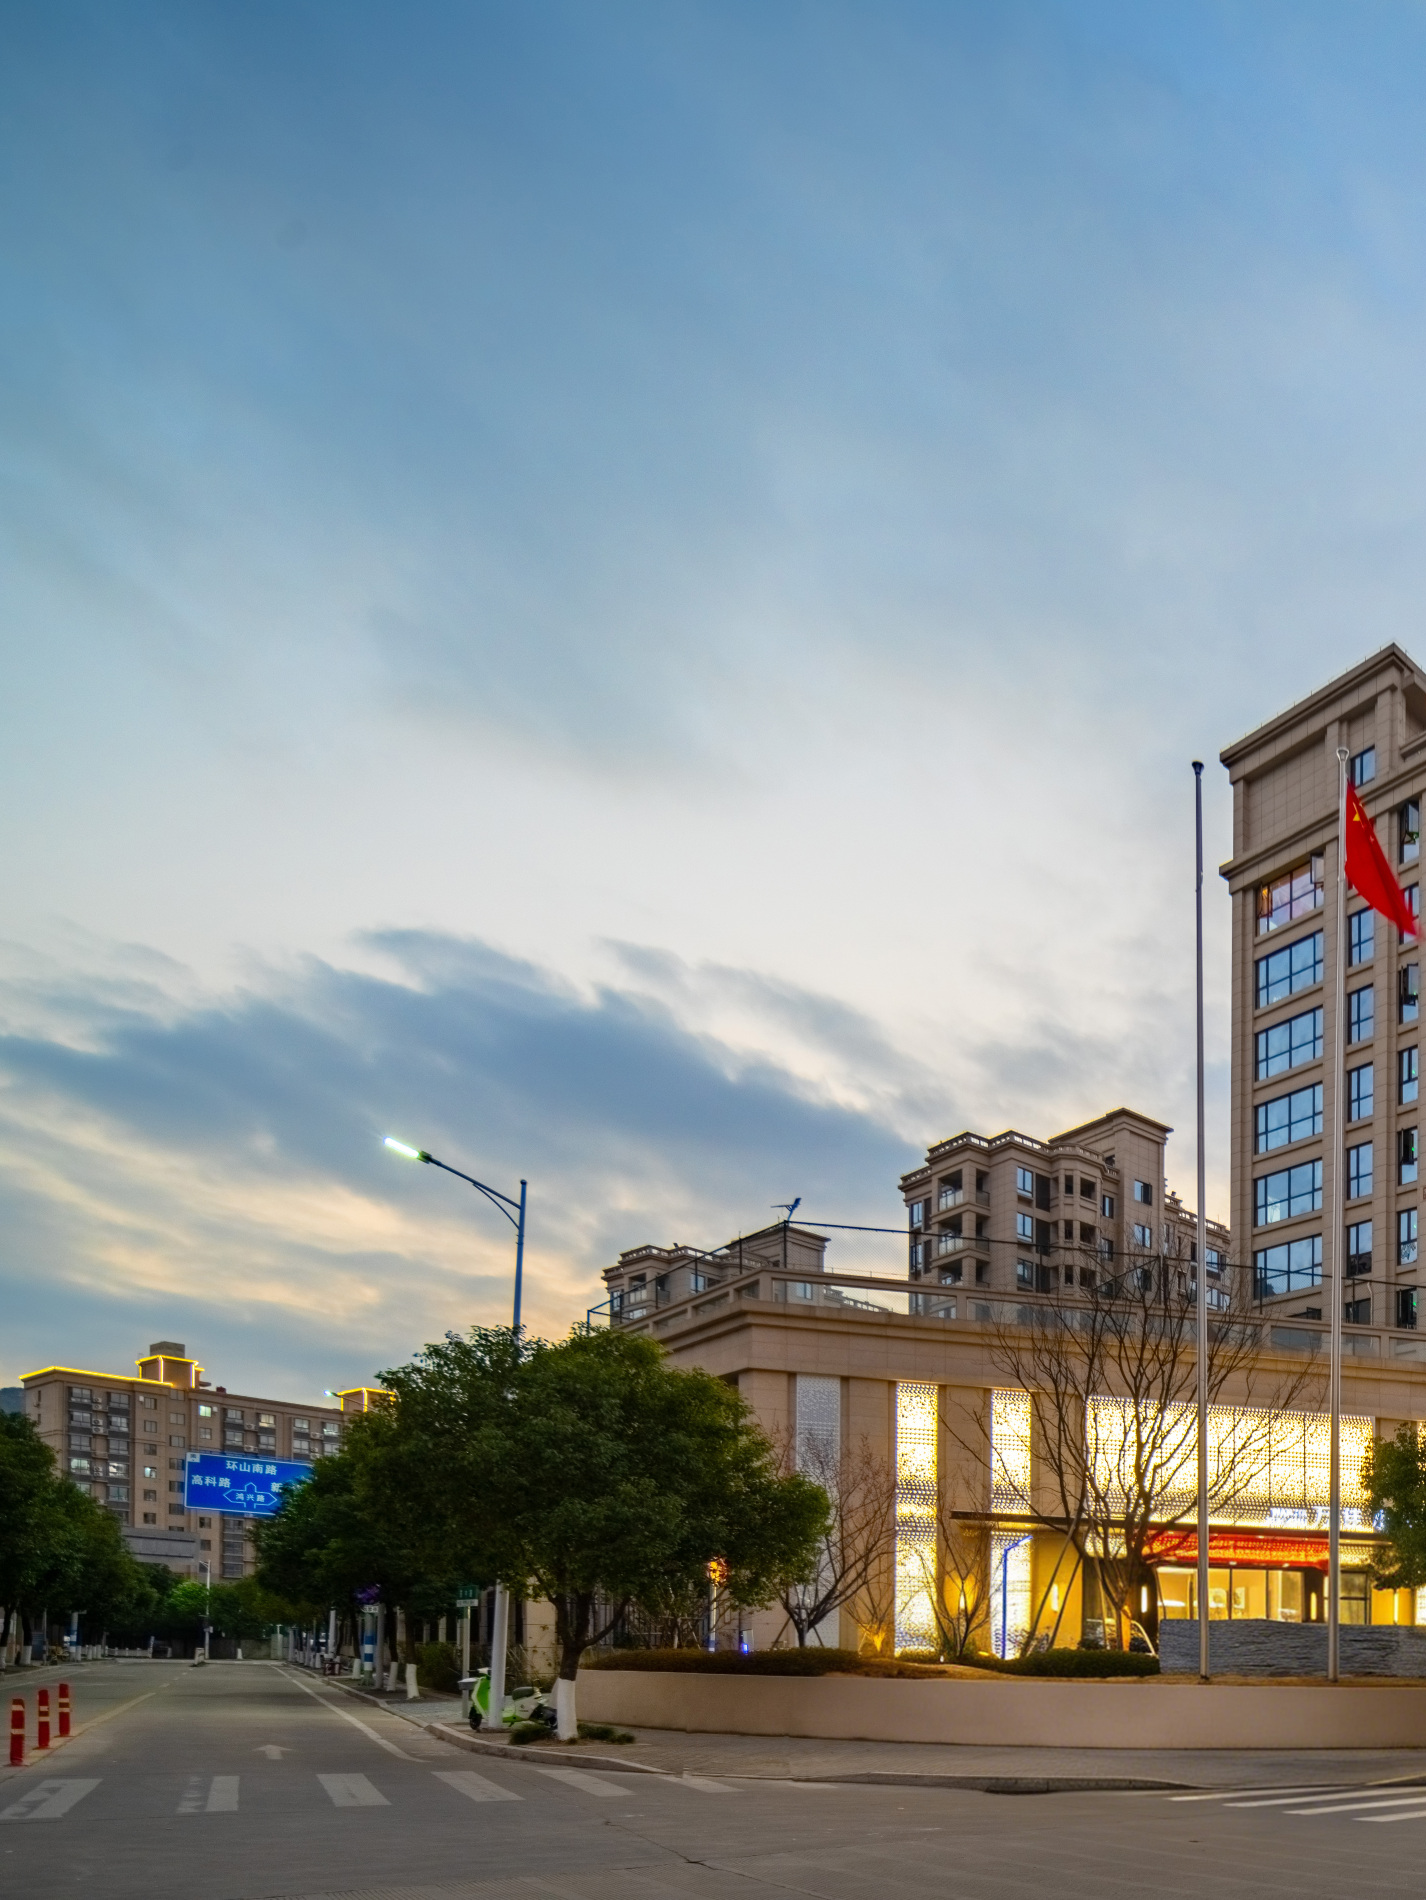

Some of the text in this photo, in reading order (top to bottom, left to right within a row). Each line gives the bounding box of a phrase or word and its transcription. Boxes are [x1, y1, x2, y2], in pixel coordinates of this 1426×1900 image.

[225, 1460, 278, 1475] 环山南路
[191, 1474, 231, 1489] 高科路
[235, 1492, 265, 1503] 鸿兴路
